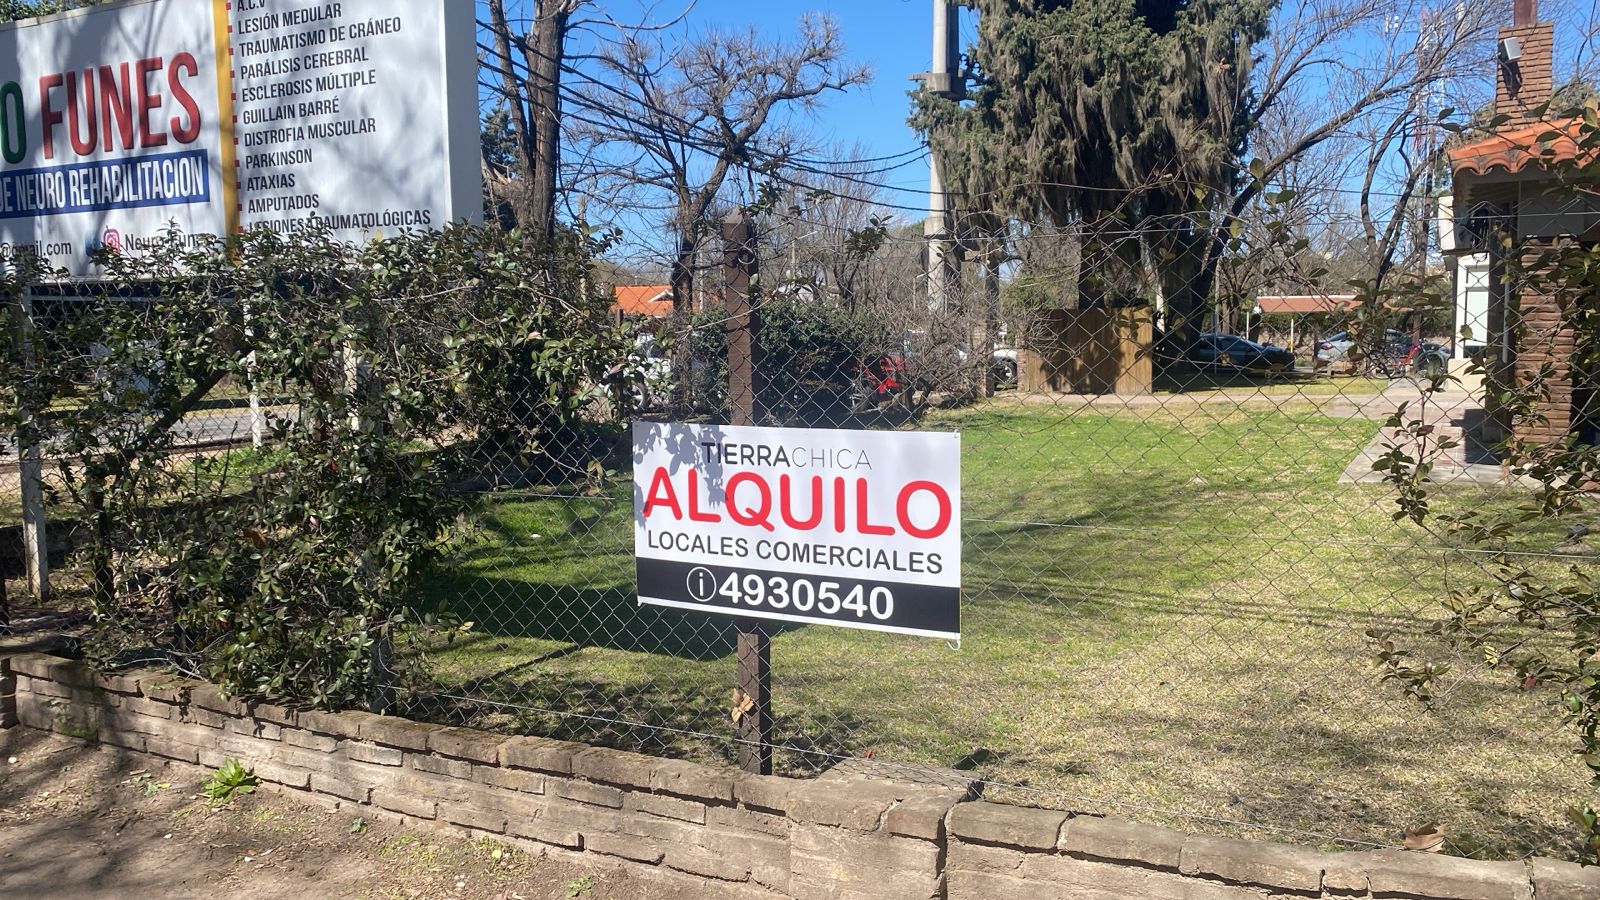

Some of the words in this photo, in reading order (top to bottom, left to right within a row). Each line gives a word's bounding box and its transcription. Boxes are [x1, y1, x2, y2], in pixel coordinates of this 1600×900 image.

[238, 13, 279, 34] LESIÓN
[282, 3, 342, 27] MEDULAR
[239, 29, 326, 57] TRAUMATISMO
[329, 26, 346, 43] DE
[350, 16, 401, 39] CRÁNEO
[240, 57, 301, 80] PARÁLISIS
[304, 46, 369, 70] CEREBRAL
[242, 79, 313, 102] ESCLEROSIS
[315, 69, 377, 92] MÚLTIPLE
[39, 51, 202, 160] FUNES
[243, 103, 296, 125] GUILLAIN
[299, 95, 340, 117] BARRÉ
[244, 126, 305, 147] DISTROFIA
[307, 117, 376, 139] MUSCULAR
[245, 148, 313, 169] PARKINSON
[15, 171, 66, 211] NEURO
[68, 156, 204, 207] REHABILITACION
[246, 173, 296, 191] ATAXIAS
[248, 194, 320, 213] AMPUTADOS
[642, 466, 952, 539] ALQUILO
[648, 530, 749, 557] LOCALES
[756, 540, 943, 574] COMERCIALES
[718, 571, 895, 620] 4930540
